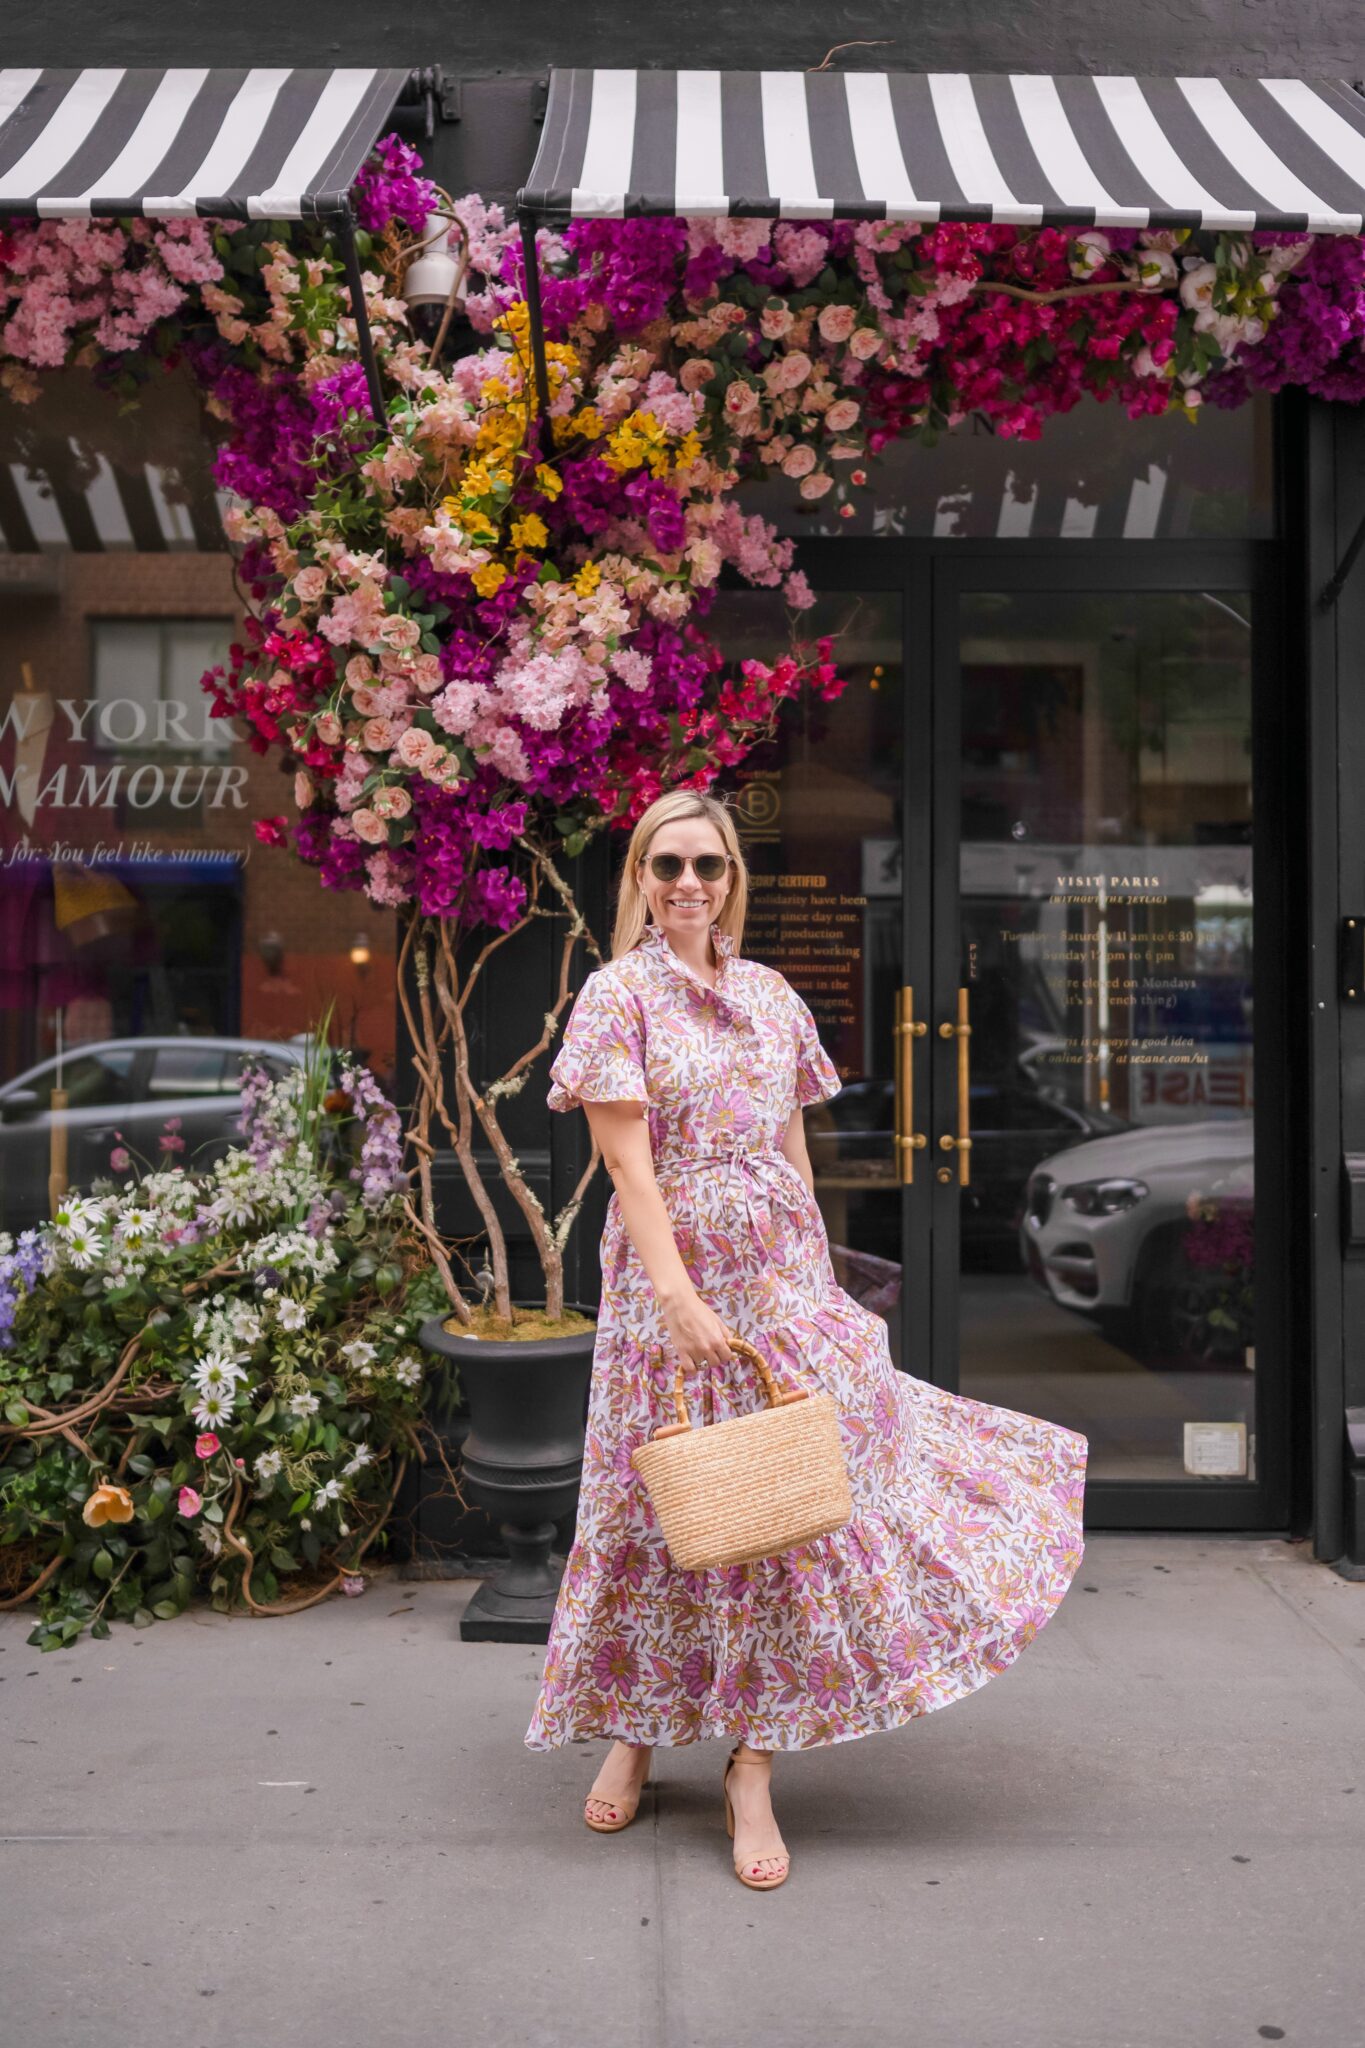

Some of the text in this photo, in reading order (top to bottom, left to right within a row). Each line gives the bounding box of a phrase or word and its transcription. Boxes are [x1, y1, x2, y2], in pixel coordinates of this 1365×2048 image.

[56, 698, 246, 743] YORK
[34, 763, 250, 809] AMOUR
[3, 840, 42, 869] for:
[50, 840, 84, 863] You
[84, 841, 124, 868] feel
[128, 841, 163, 862] like
[168, 844, 251, 869] summer)
[778, 874, 827, 888] CERTIFIED
[1056, 876, 1160, 888] VISIT PARIS
[753, 894, 808, 908] solidarity
[810, 893, 836, 905] have
[839, 893, 868, 905] been
[1126, 895, 1168, 906] JETLAG)
[780, 911, 809, 922] since
[811, 910, 833, 925] day
[835, 913, 860, 923] one.
[764, 928, 777, 939] of
[780, 927, 844, 942] production
[1130, 933, 1149, 942] am
[1152, 933, 1165, 942] to
[1168, 931, 1194, 943] 6:30
[787, 944, 810, 956] and
[812, 944, 863, 960] working
[1156, 952, 1176, 965] pm
[968, 943, 977, 979] PULL
[816, 978, 829, 990] in
[831, 978, 850, 990] the
[1122, 979, 1139, 989] on
[1142, 977, 1197, 991] Mondays
[1141, 993, 1178, 1009] thing)
[839, 1015, 856, 1024] we
[1140, 1036, 1169, 1050] good
[1170, 1035, 1195, 1047] idea
[1048, 1052, 1084, 1064] online
[1116, 1054, 1128, 1064] at
[1129, 1052, 1210, 1065] sezane.com/us
